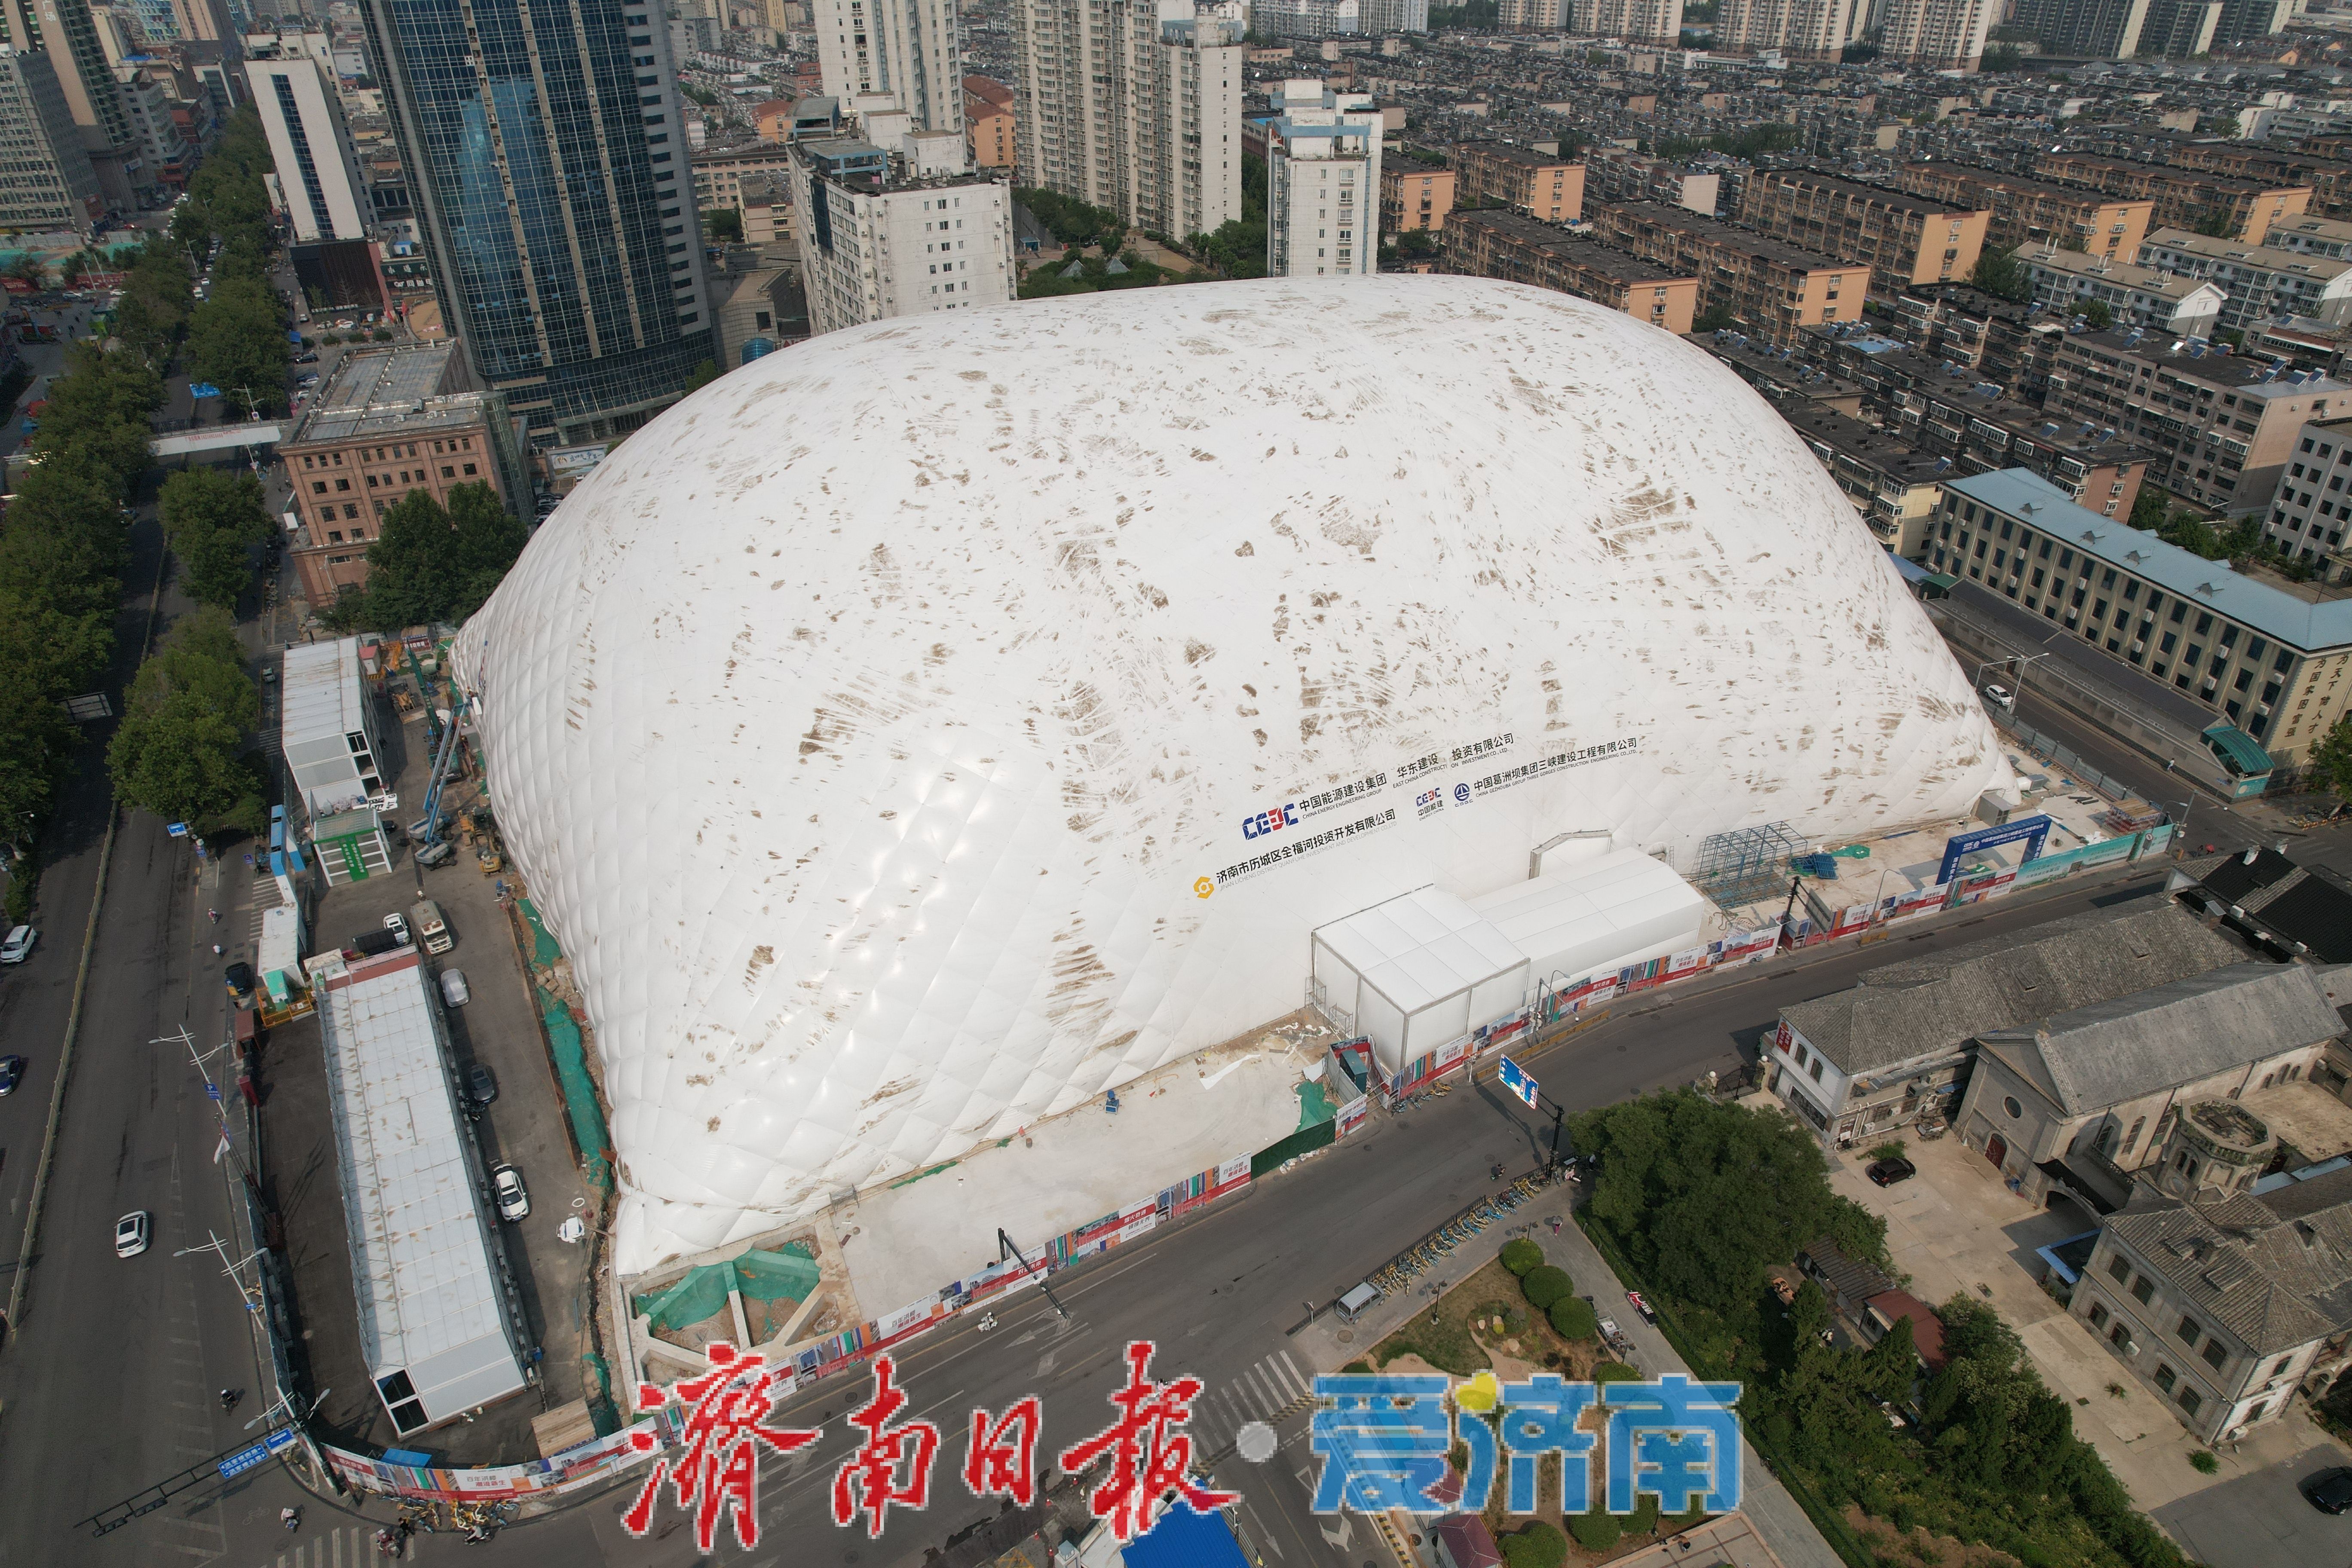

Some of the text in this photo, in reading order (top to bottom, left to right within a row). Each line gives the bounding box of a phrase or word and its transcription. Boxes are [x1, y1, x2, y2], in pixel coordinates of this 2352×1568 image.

[2285, 657, 2326, 737] 为国家图富强
[2308, 653, 2349, 733] 为天下储人才
[1396, 733, 1514, 778] 华东建设 投资有限公司
[1405, 776, 1419, 784] CHINA
[1462, 753, 1490, 766] INVESTMENT
[1474, 737, 1637, 791] 中国葛洲坝集团三峡建设工程有限公司
[1489, 783, 1511, 794] GEZHOUBA
[1512, 778, 1526, 787] GROUP
[1527, 774, 1539, 782] THREE
[1540, 769, 1556, 778] GORGES
[1556, 760, 1589, 773] CONSTRUCTION
[1590, 753, 1619, 763] ENGINEERING
[1299, 772, 1387, 812] 中国能源建设集团
[1302, 788, 1382, 819] CHINA ENERGY ENGINEERING GROUP
[1418, 800, 1444, 816] 中国能建
[1216, 808, 1396, 884] 济南市历城区全福河投资开发有限公司
[1220, 880, 1234, 891] JINAN
[1234, 873, 1256, 885] LICHENG
[1257, 865, 1277, 878] DISTRICT
[1306, 845, 1335, 858] INVESTMENT
[1347, 827, 1380, 843] DEVELOPMENT
